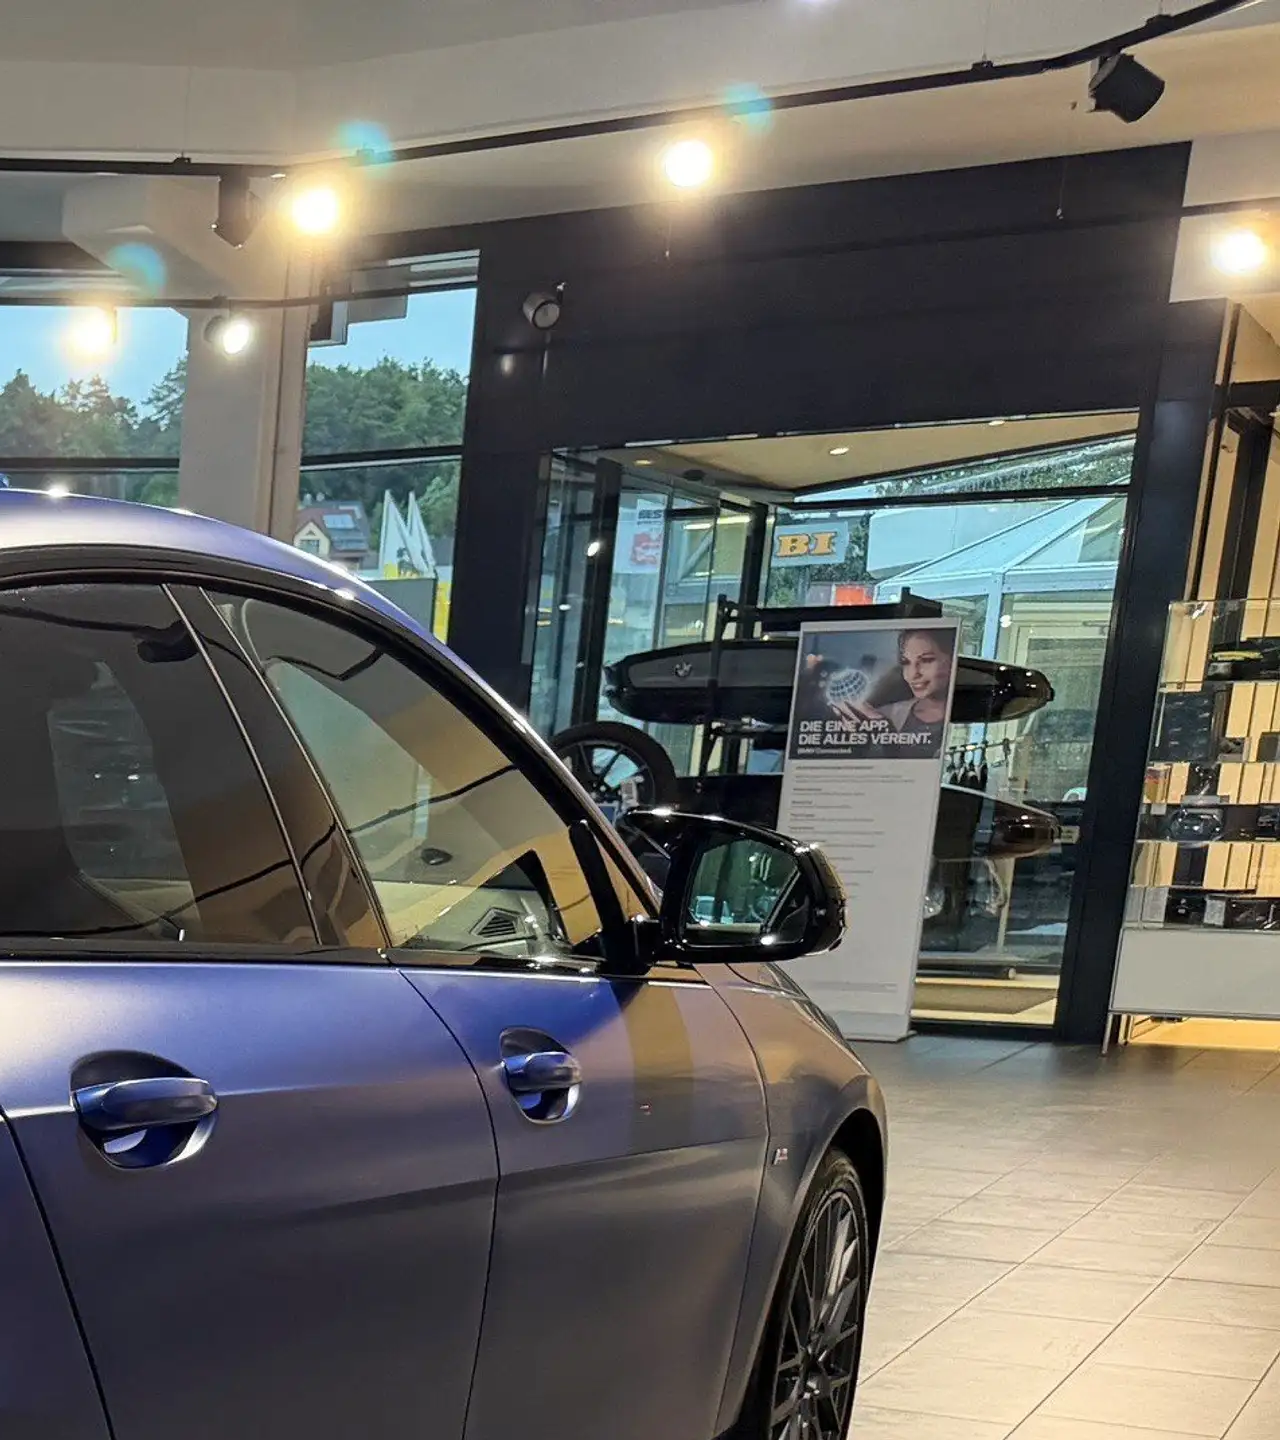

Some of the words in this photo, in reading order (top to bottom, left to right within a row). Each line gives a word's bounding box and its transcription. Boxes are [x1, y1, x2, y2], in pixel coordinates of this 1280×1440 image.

[800, 720, 823, 732] DIE
[825, 720, 857, 732] EINE
[798, 733, 821, 745] DIE
[823, 733, 868, 745] ALLES
[870, 732, 932, 745] VEREINT.
